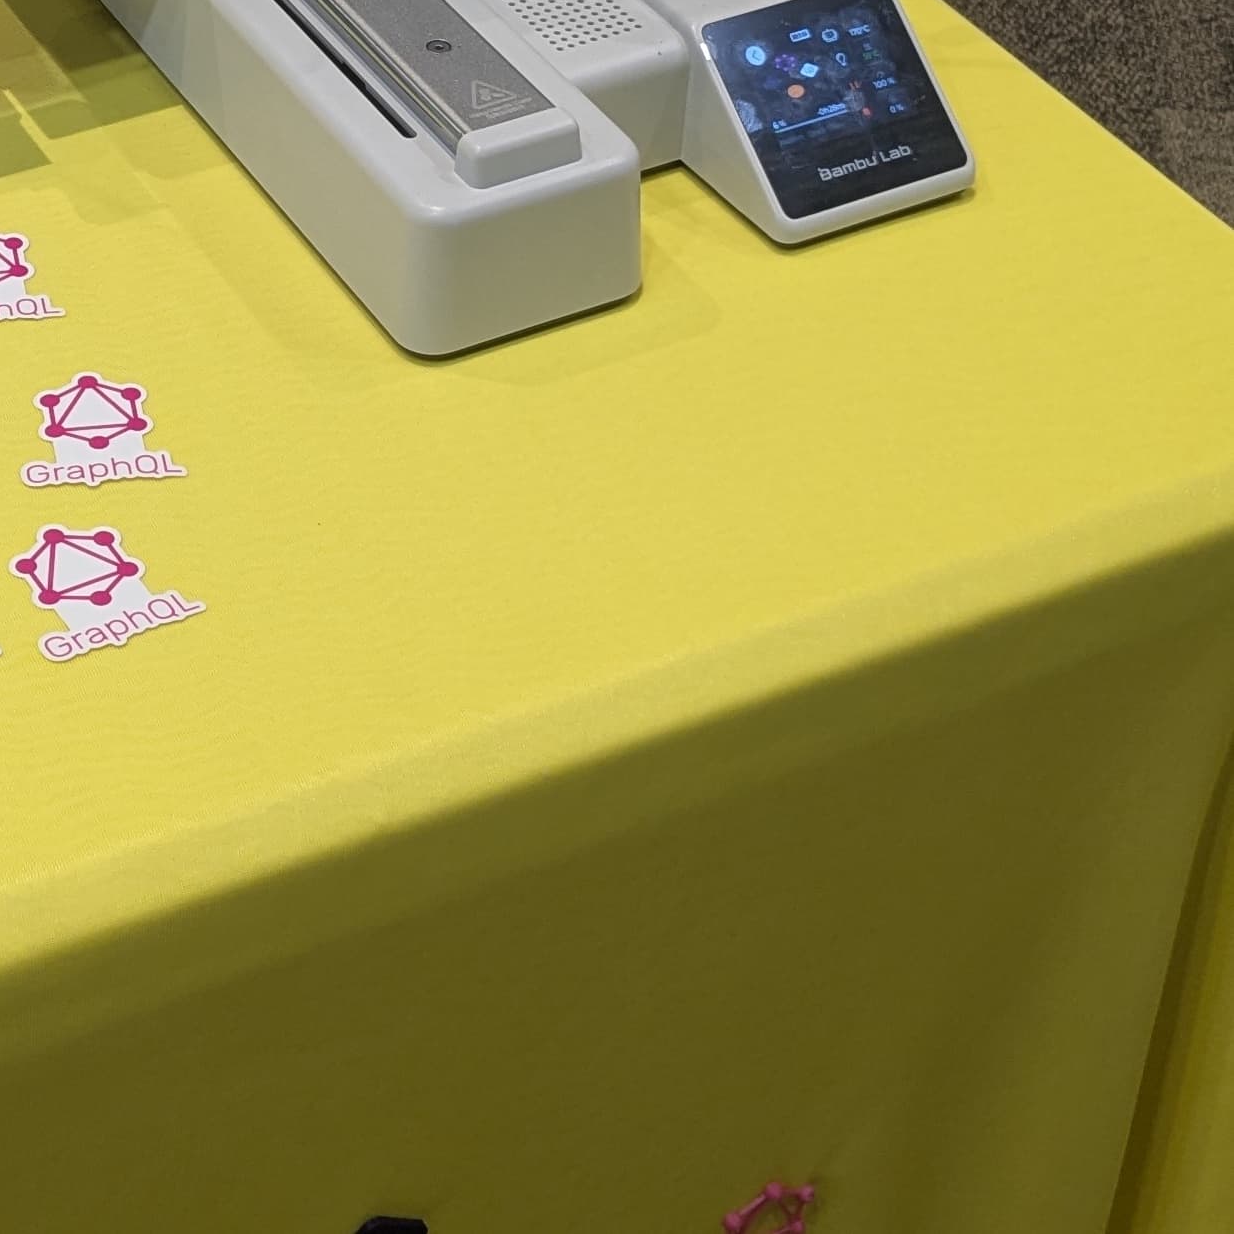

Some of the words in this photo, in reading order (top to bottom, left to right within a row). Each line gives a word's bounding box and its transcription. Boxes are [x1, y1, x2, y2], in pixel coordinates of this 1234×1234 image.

[817, 155, 878, 182] Bambu
[879, 144, 912, 161] Lab
[26, 454, 182, 485] GraphQL
[44, 597, 199, 659] GraphQL
